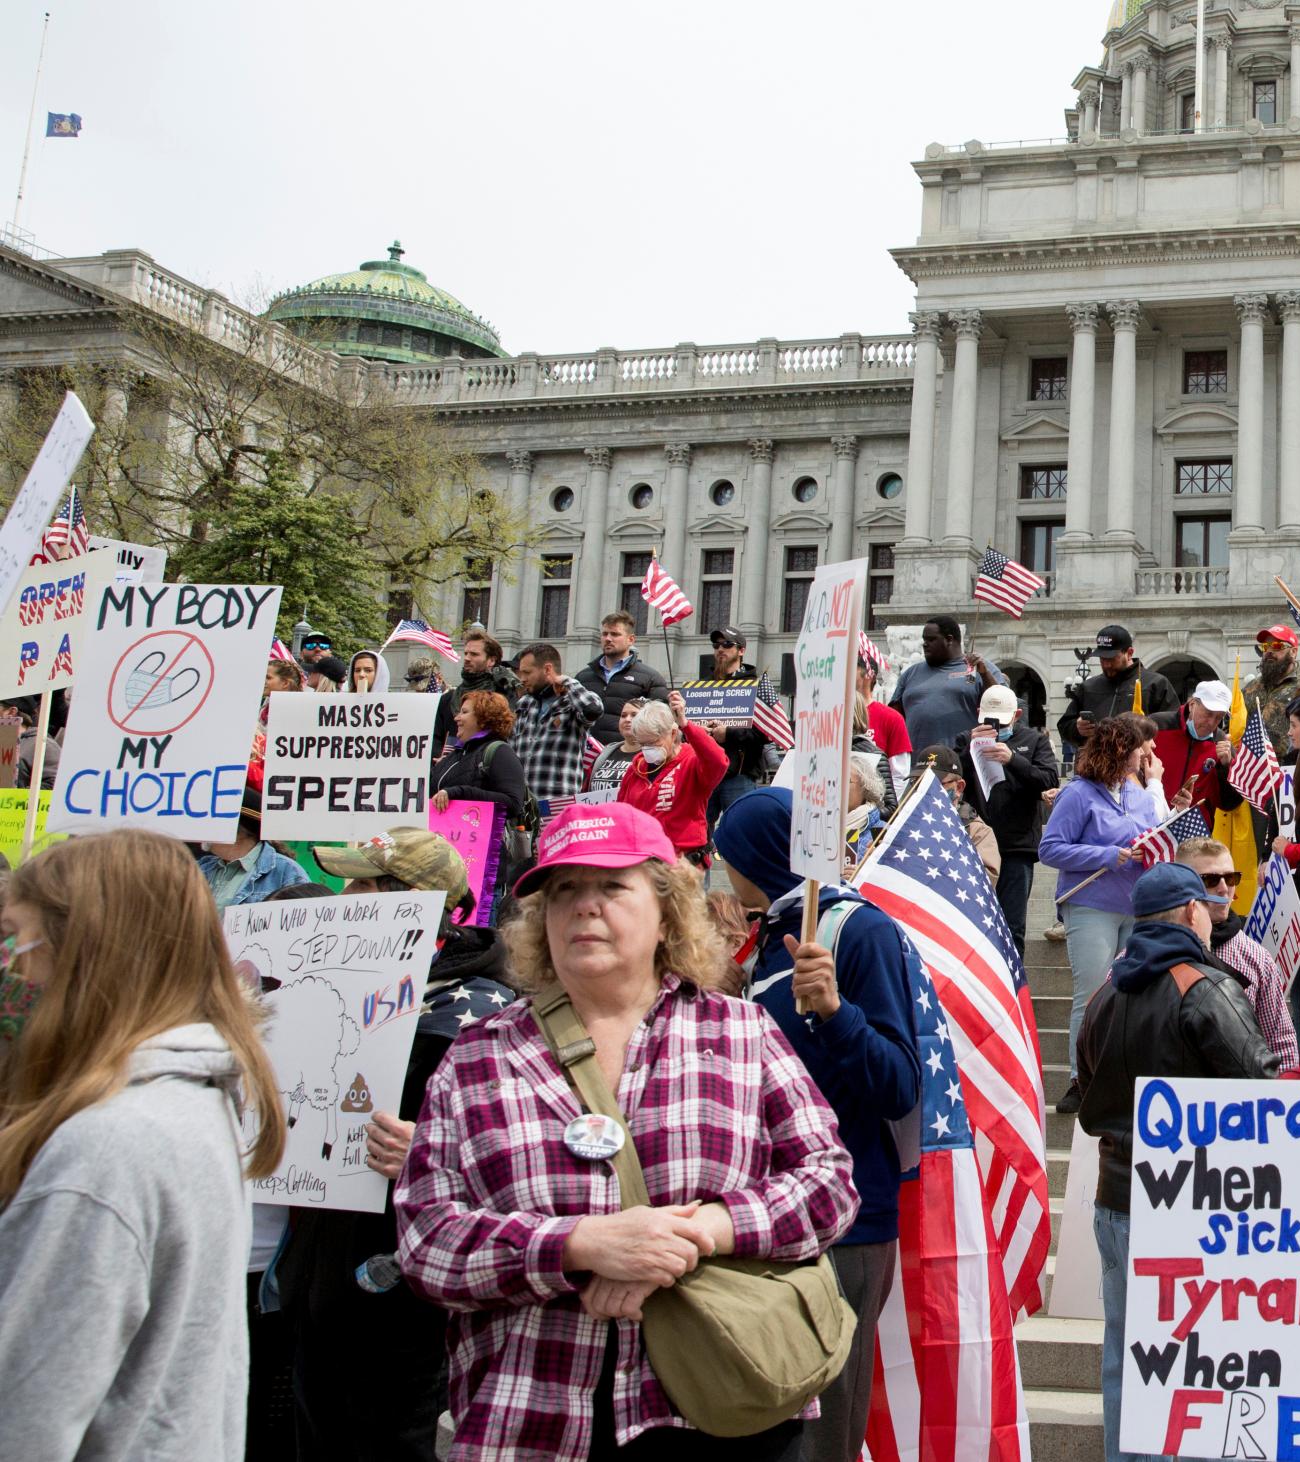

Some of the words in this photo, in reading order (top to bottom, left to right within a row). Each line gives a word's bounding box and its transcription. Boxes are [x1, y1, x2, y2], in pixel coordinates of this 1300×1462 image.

[19, 572, 86, 626] OPEN
[97, 586, 170, 631] MY
[176, 585, 277, 630] BODY
[686, 690, 711, 698] Loosen
[713, 689, 725, 697] the
[726, 688, 752, 697] SCREW
[703, 706, 749, 714] Construction
[116, 734, 173, 769] MY
[275, 735, 402, 760] SUPPRESSION
[406, 735, 429, 759] OF
[65, 764, 246, 818] CHOICE
[267, 775, 425, 813] SPEECH
[570, 829, 609, 844] AGAIN
[280, 907, 307, 931] WHO
[314, 905, 337, 933] YOU
[342, 900, 380, 922] WORK
[287, 933, 339, 972] STEP
[363, 973, 415, 1029] USA
